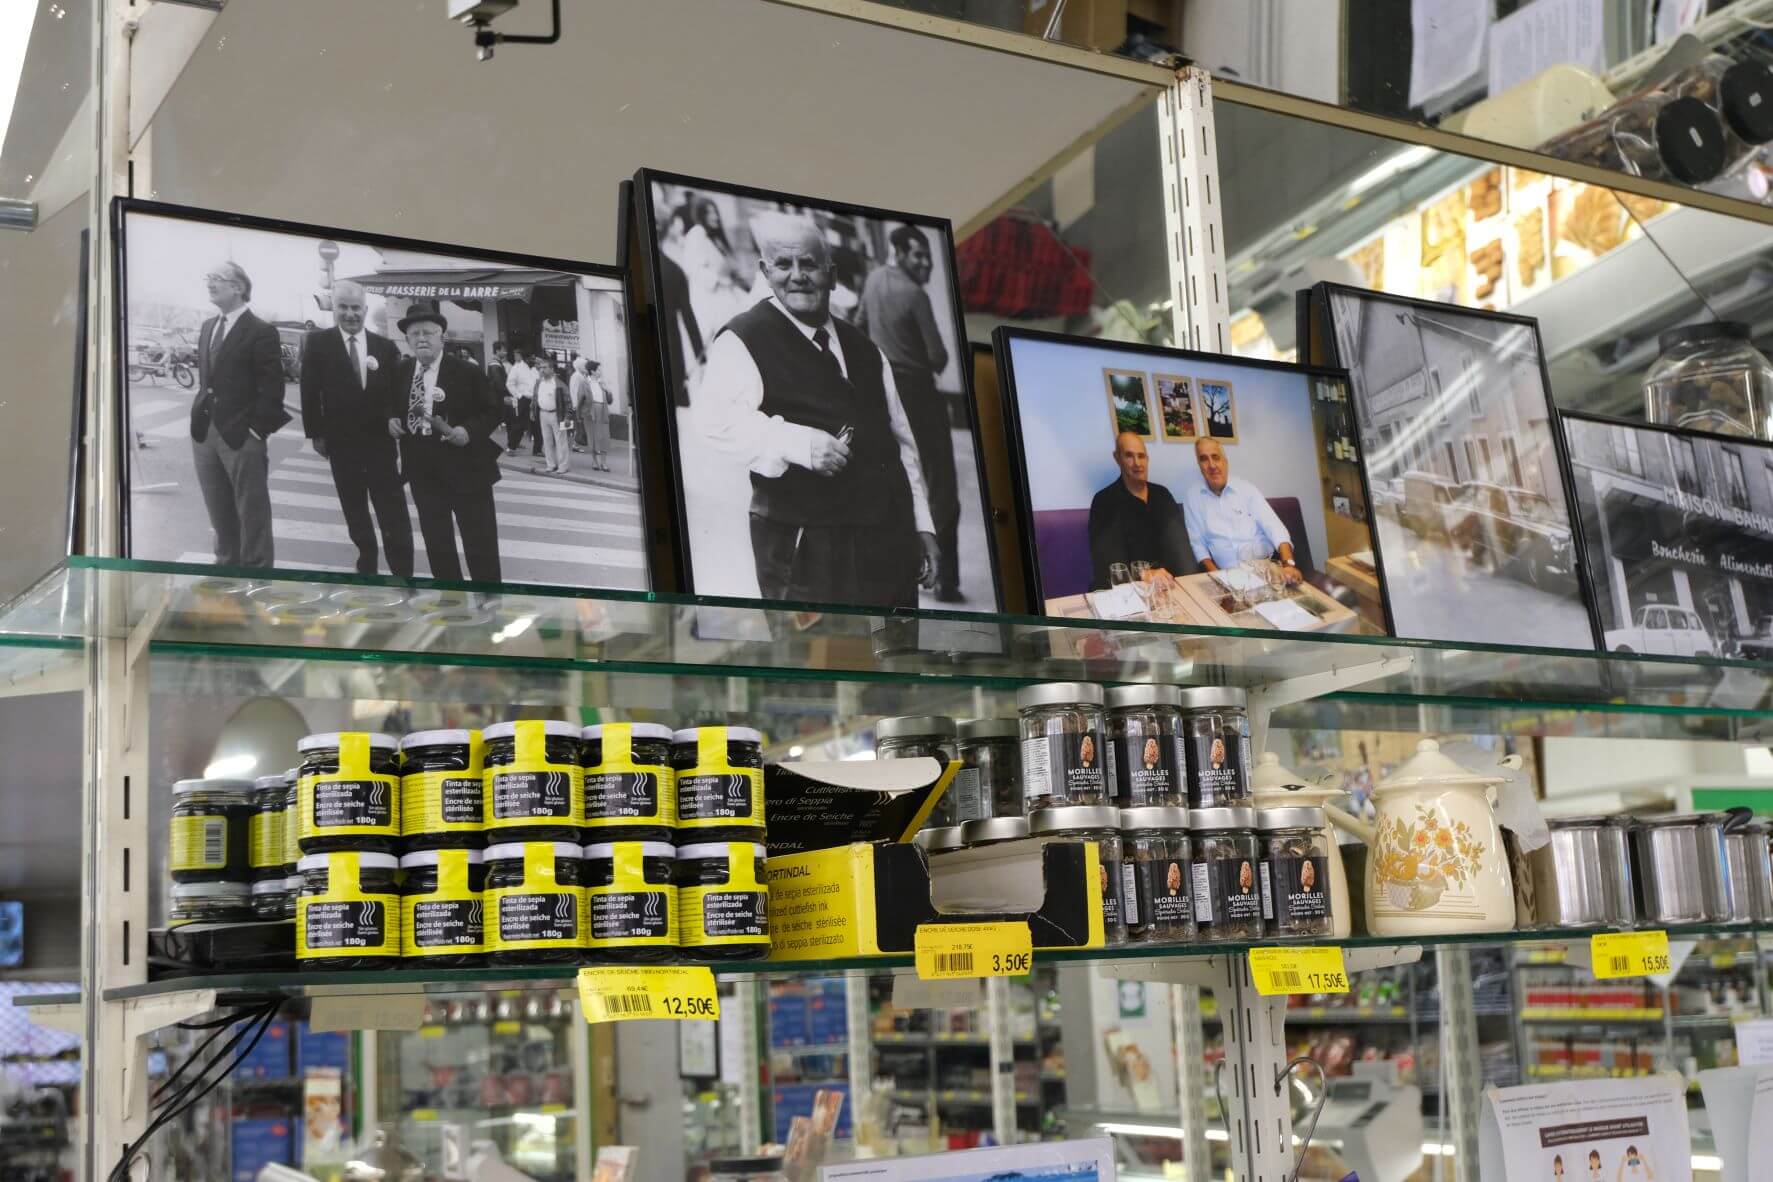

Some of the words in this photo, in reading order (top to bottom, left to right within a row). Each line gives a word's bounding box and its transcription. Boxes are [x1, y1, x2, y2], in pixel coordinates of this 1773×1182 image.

[386, 286, 436, 297] BRASSERIE
[438, 288, 449, 296] DE
[450, 288, 461, 296] LA
[464, 286, 499, 297] BARRE
[1734, 508, 1773, 534] BAHA
[1652, 540, 1705, 565] Boucherie
[1720, 553, 1773, 577] Alimentati
[1198, 768, 1236, 776] MORILLES
[798, 796, 834, 807] Seppia
[532, 808, 553, 816] 180g
[618, 808, 639, 816] 180g
[715, 808, 736, 816] 180g
[818, 812, 854, 820] Seiche
[356, 816, 376, 825] 180g
[768, 864, 811, 881] ORTINDAL
[528, 896, 546, 904] sepia
[617, 895, 635, 903] sepia
[733, 894, 749, 902] sepia
[1154, 896, 1190, 904] MORILLES
[1288, 892, 1324, 900] MORILLES
[542, 930, 562, 938] 180g
[631, 928, 652, 936] 180g
[746, 926, 762, 935] 180g
[344, 938, 366, 946] 180g
[454, 936, 476, 944] 180g
[992, 952, 1030, 976] 3,50€
[1642, 954, 1670, 973] 15,50€
[1307, 972, 1346, 992] 17,50€
[663, 996, 716, 1018] 12,50€
